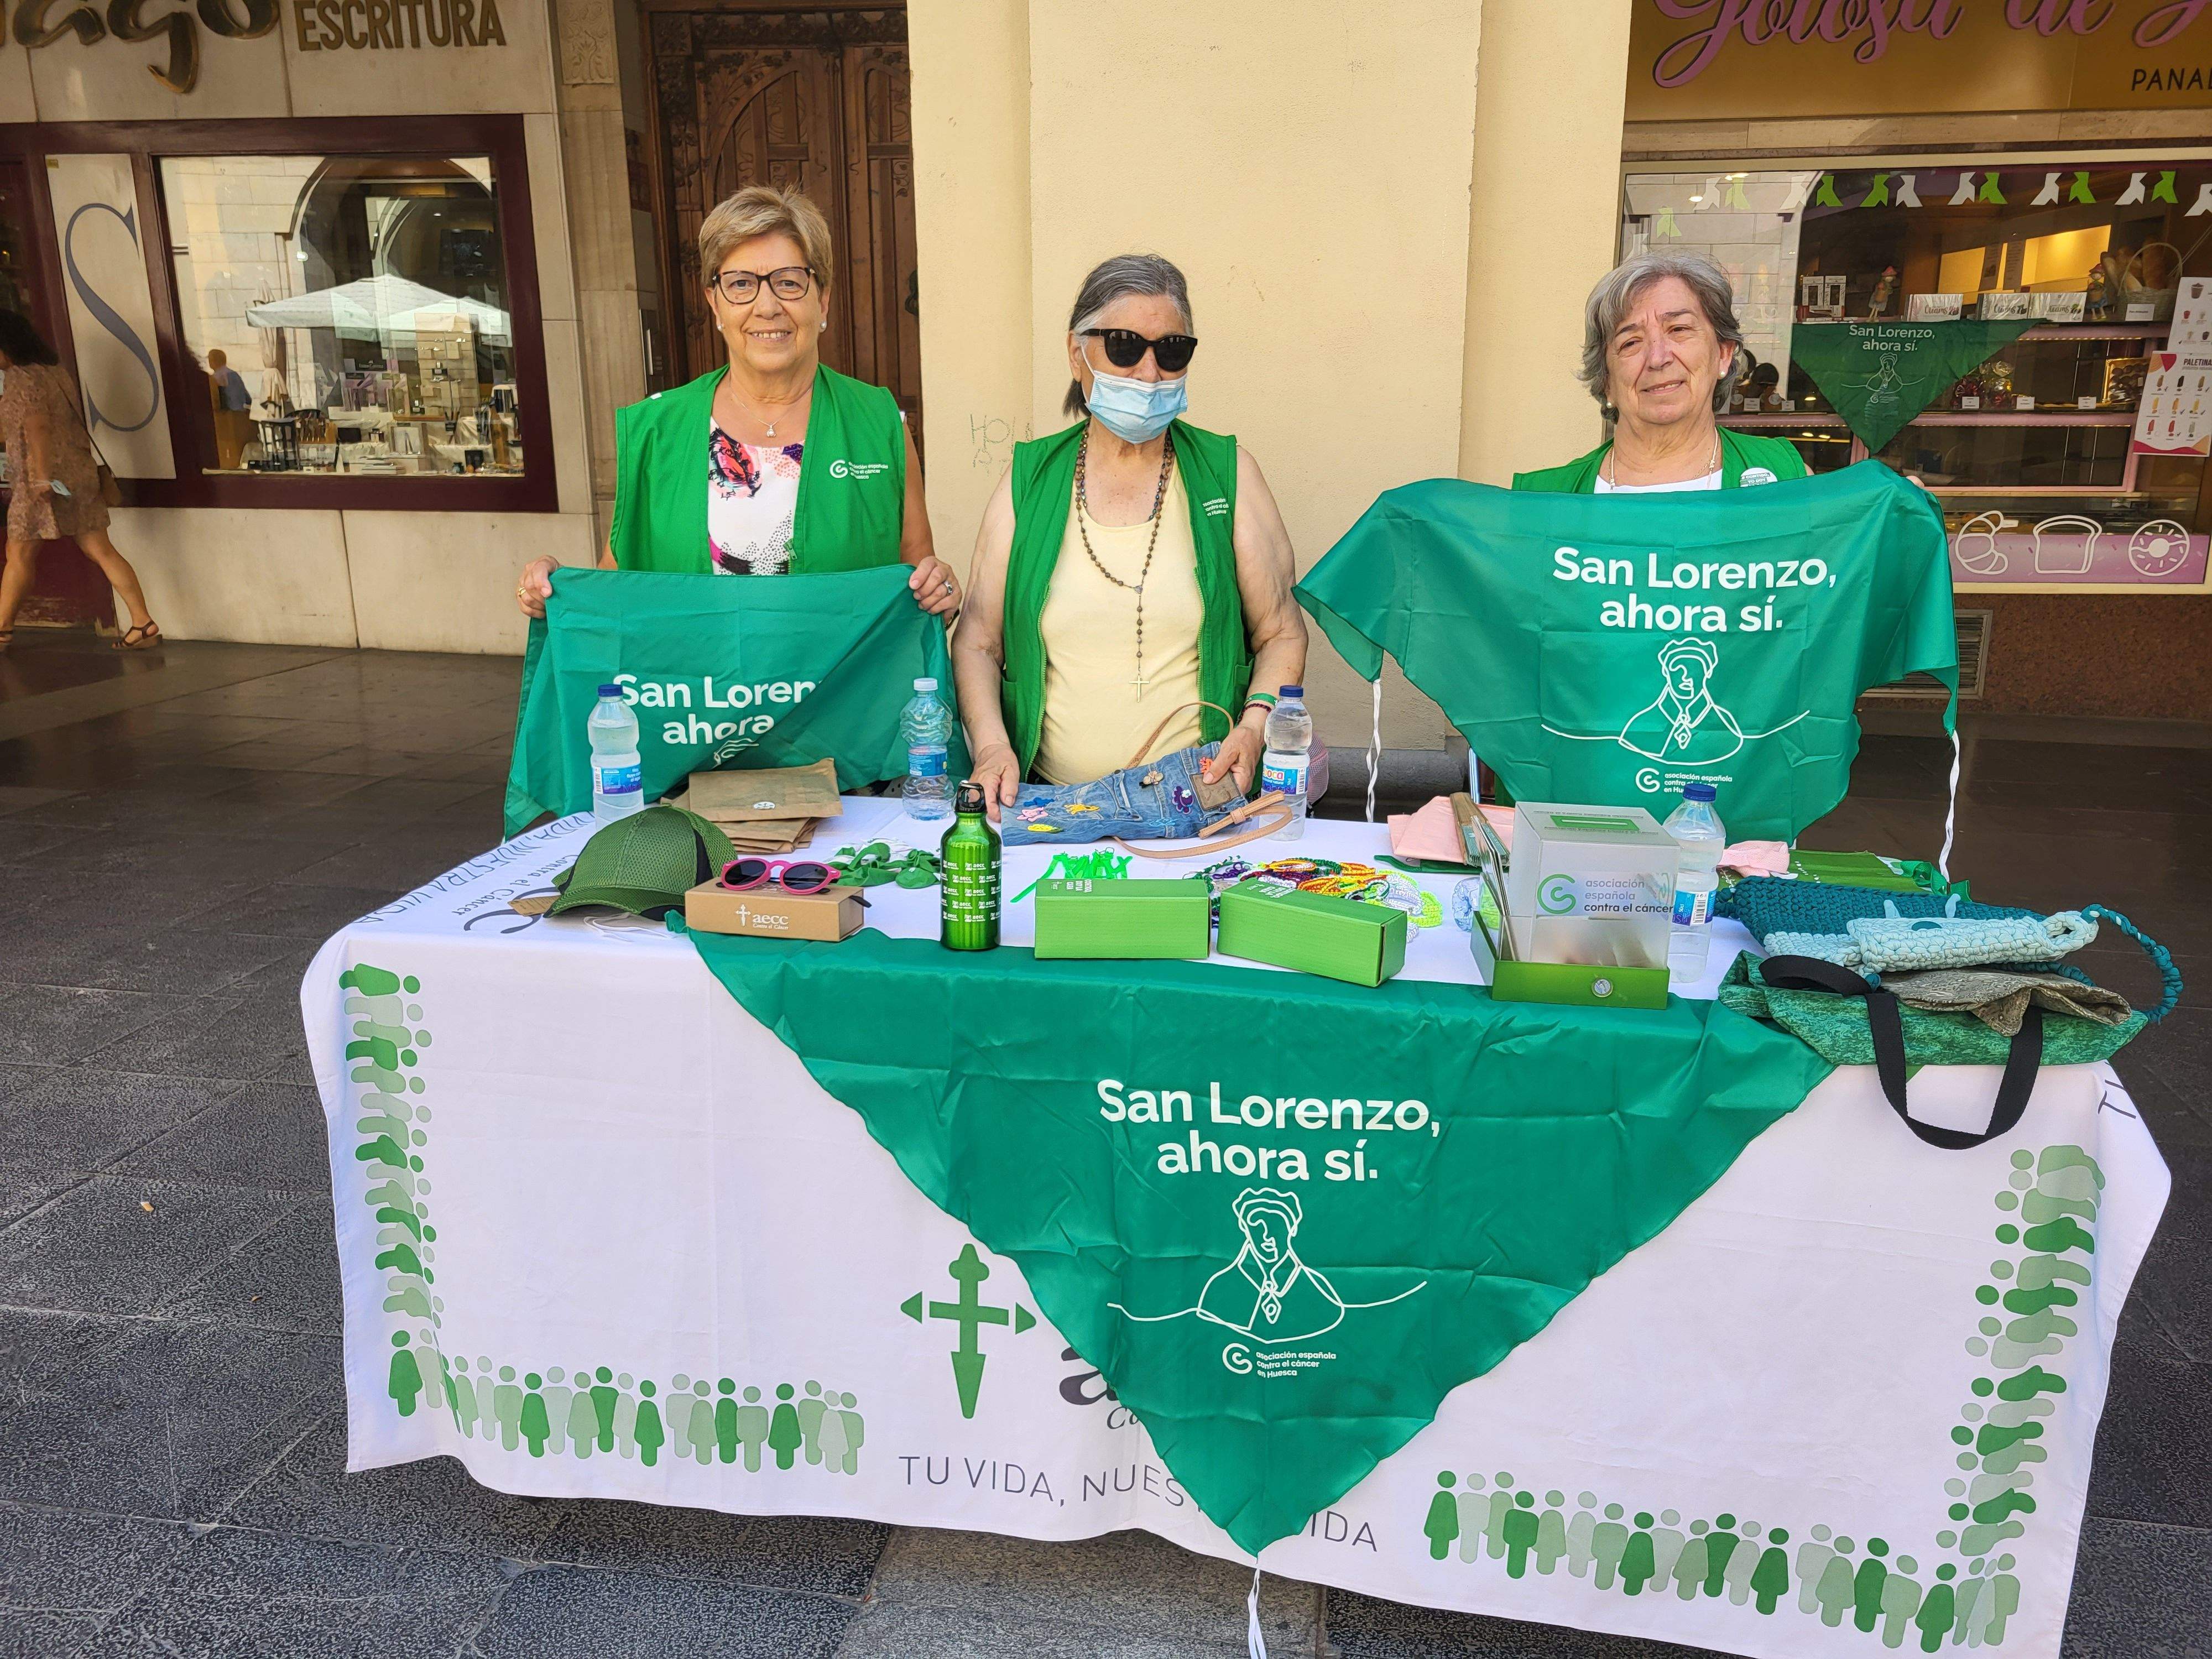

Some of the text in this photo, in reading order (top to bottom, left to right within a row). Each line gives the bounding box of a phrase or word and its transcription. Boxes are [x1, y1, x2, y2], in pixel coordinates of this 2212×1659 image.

[299, 0, 507, 51] ESCRITURA
[65, 202, 160, 432] S
[1849, 325, 1936, 339] San Lorenzo,
[1863, 338, 1929, 351] ahora sí.
[1553, 546, 1837, 589] San Lorenzo,
[1600, 593, 1783, 632] ahora sí.
[613, 674, 823, 708] San Loren
[662, 713, 774, 744] ahora
[1585, 879, 1645, 888] asociación
[1585, 891, 1635, 901] española
[1584, 903, 1674, 913] contra el cáncer
[753, 914, 789, 925] aecc
[1097, 1079, 1439, 1138] San Lorenzo,
[1157, 1129, 1378, 1182] ahora sí.
[1256, 1352, 1337, 1360] asociación española
[1256, 1360, 1280, 1369] contra
[1267, 1370, 1297, 1378] Huesca
[899, 1456, 1377, 1552] TU VIDA, NUES IDA
